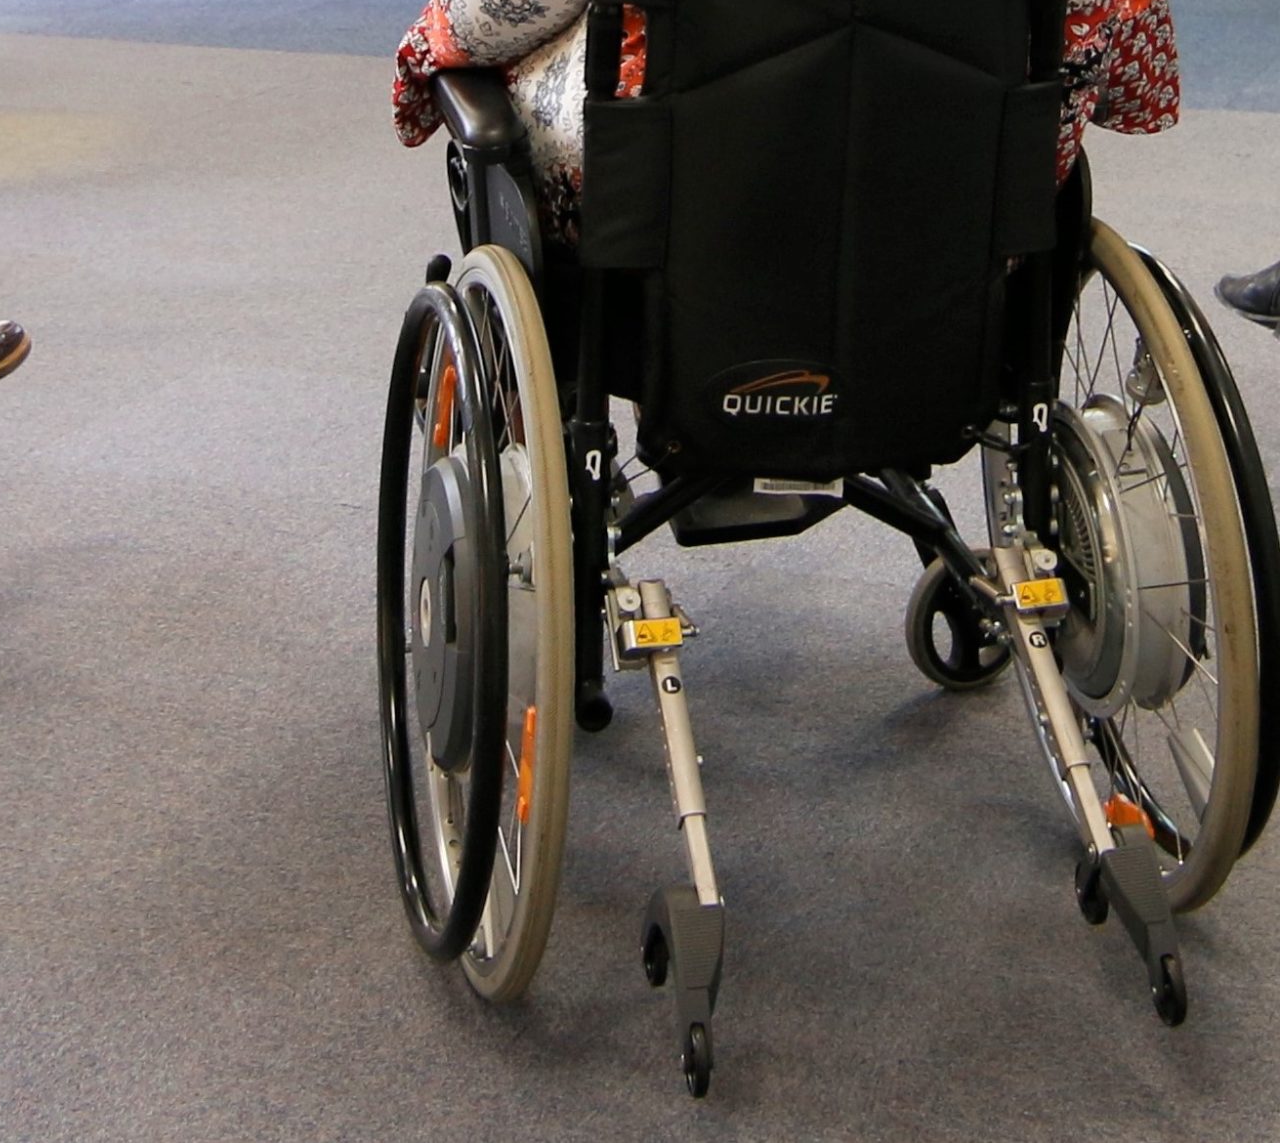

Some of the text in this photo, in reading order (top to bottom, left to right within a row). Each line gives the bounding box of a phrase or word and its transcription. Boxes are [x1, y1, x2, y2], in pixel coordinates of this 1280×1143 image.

[723, 394, 834, 416] QUICKIE
[1031, 634, 1046, 647] R
[666, 678, 678, 692] L
